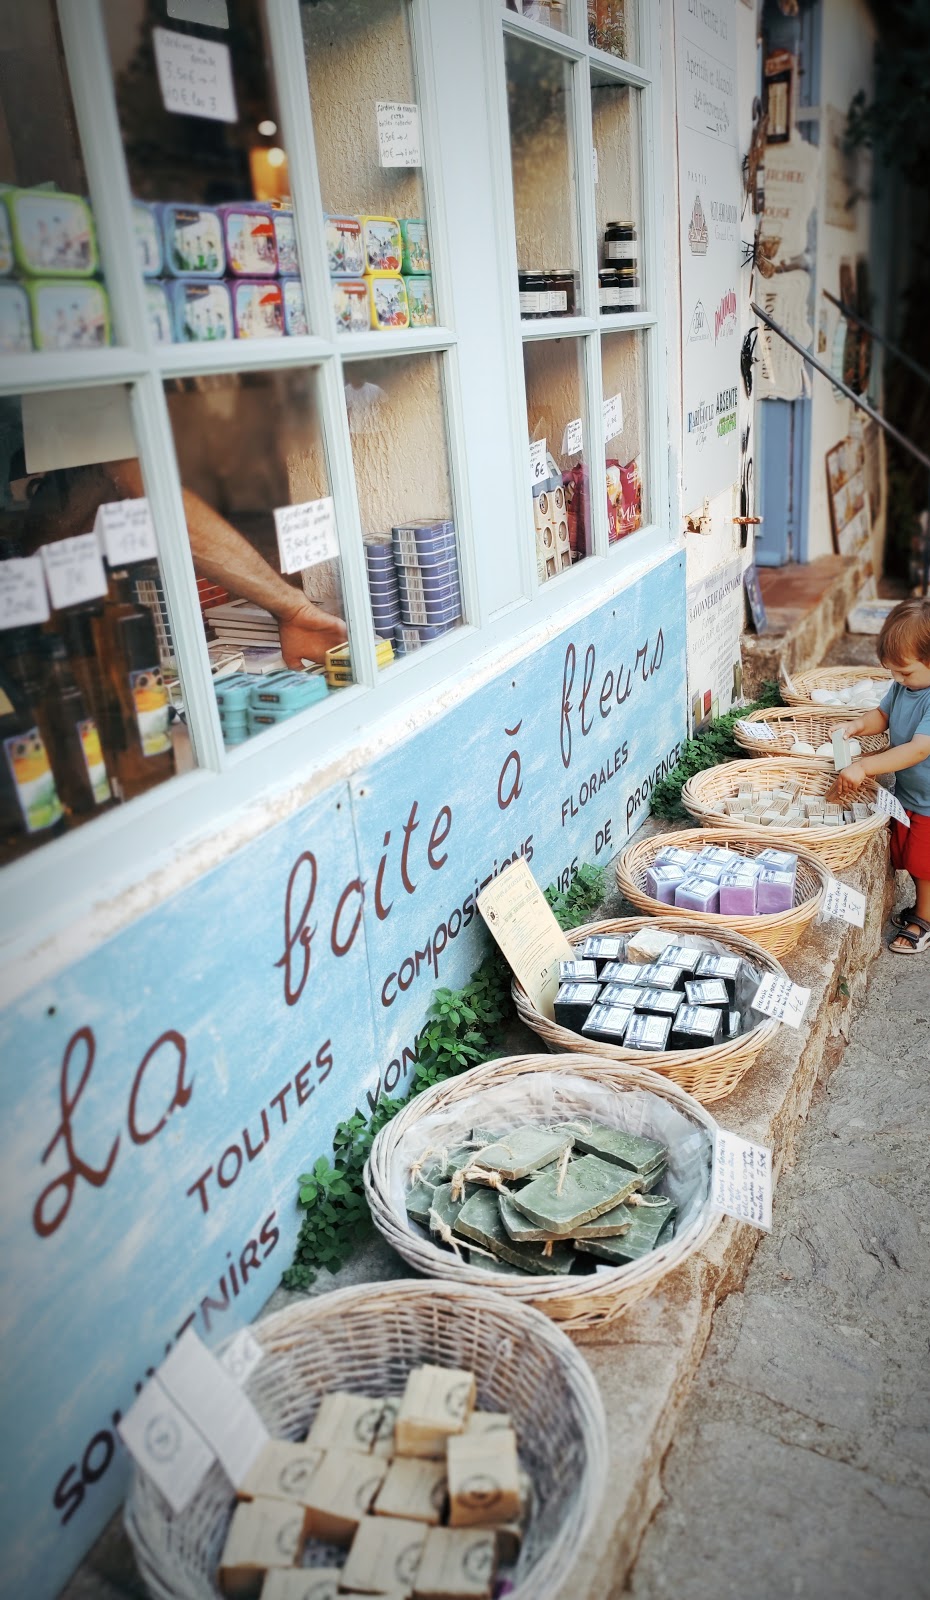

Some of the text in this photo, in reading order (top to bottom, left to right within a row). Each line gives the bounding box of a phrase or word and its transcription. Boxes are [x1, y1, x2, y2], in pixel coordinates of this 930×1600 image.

[716, 386, 738, 416] ABSENTE
[595, 819, 612, 855] DE
[626, 742, 681, 835] PROVENCE
[33, 1025, 197, 1239] La
[273, 800, 453, 1007] boite
[560, 627, 665, 769] fleurs
[187, 1038, 333, 1214] TOUTES
[561, 741, 628, 827] FLORALES
[787, 994, 804, 1014] 4€
